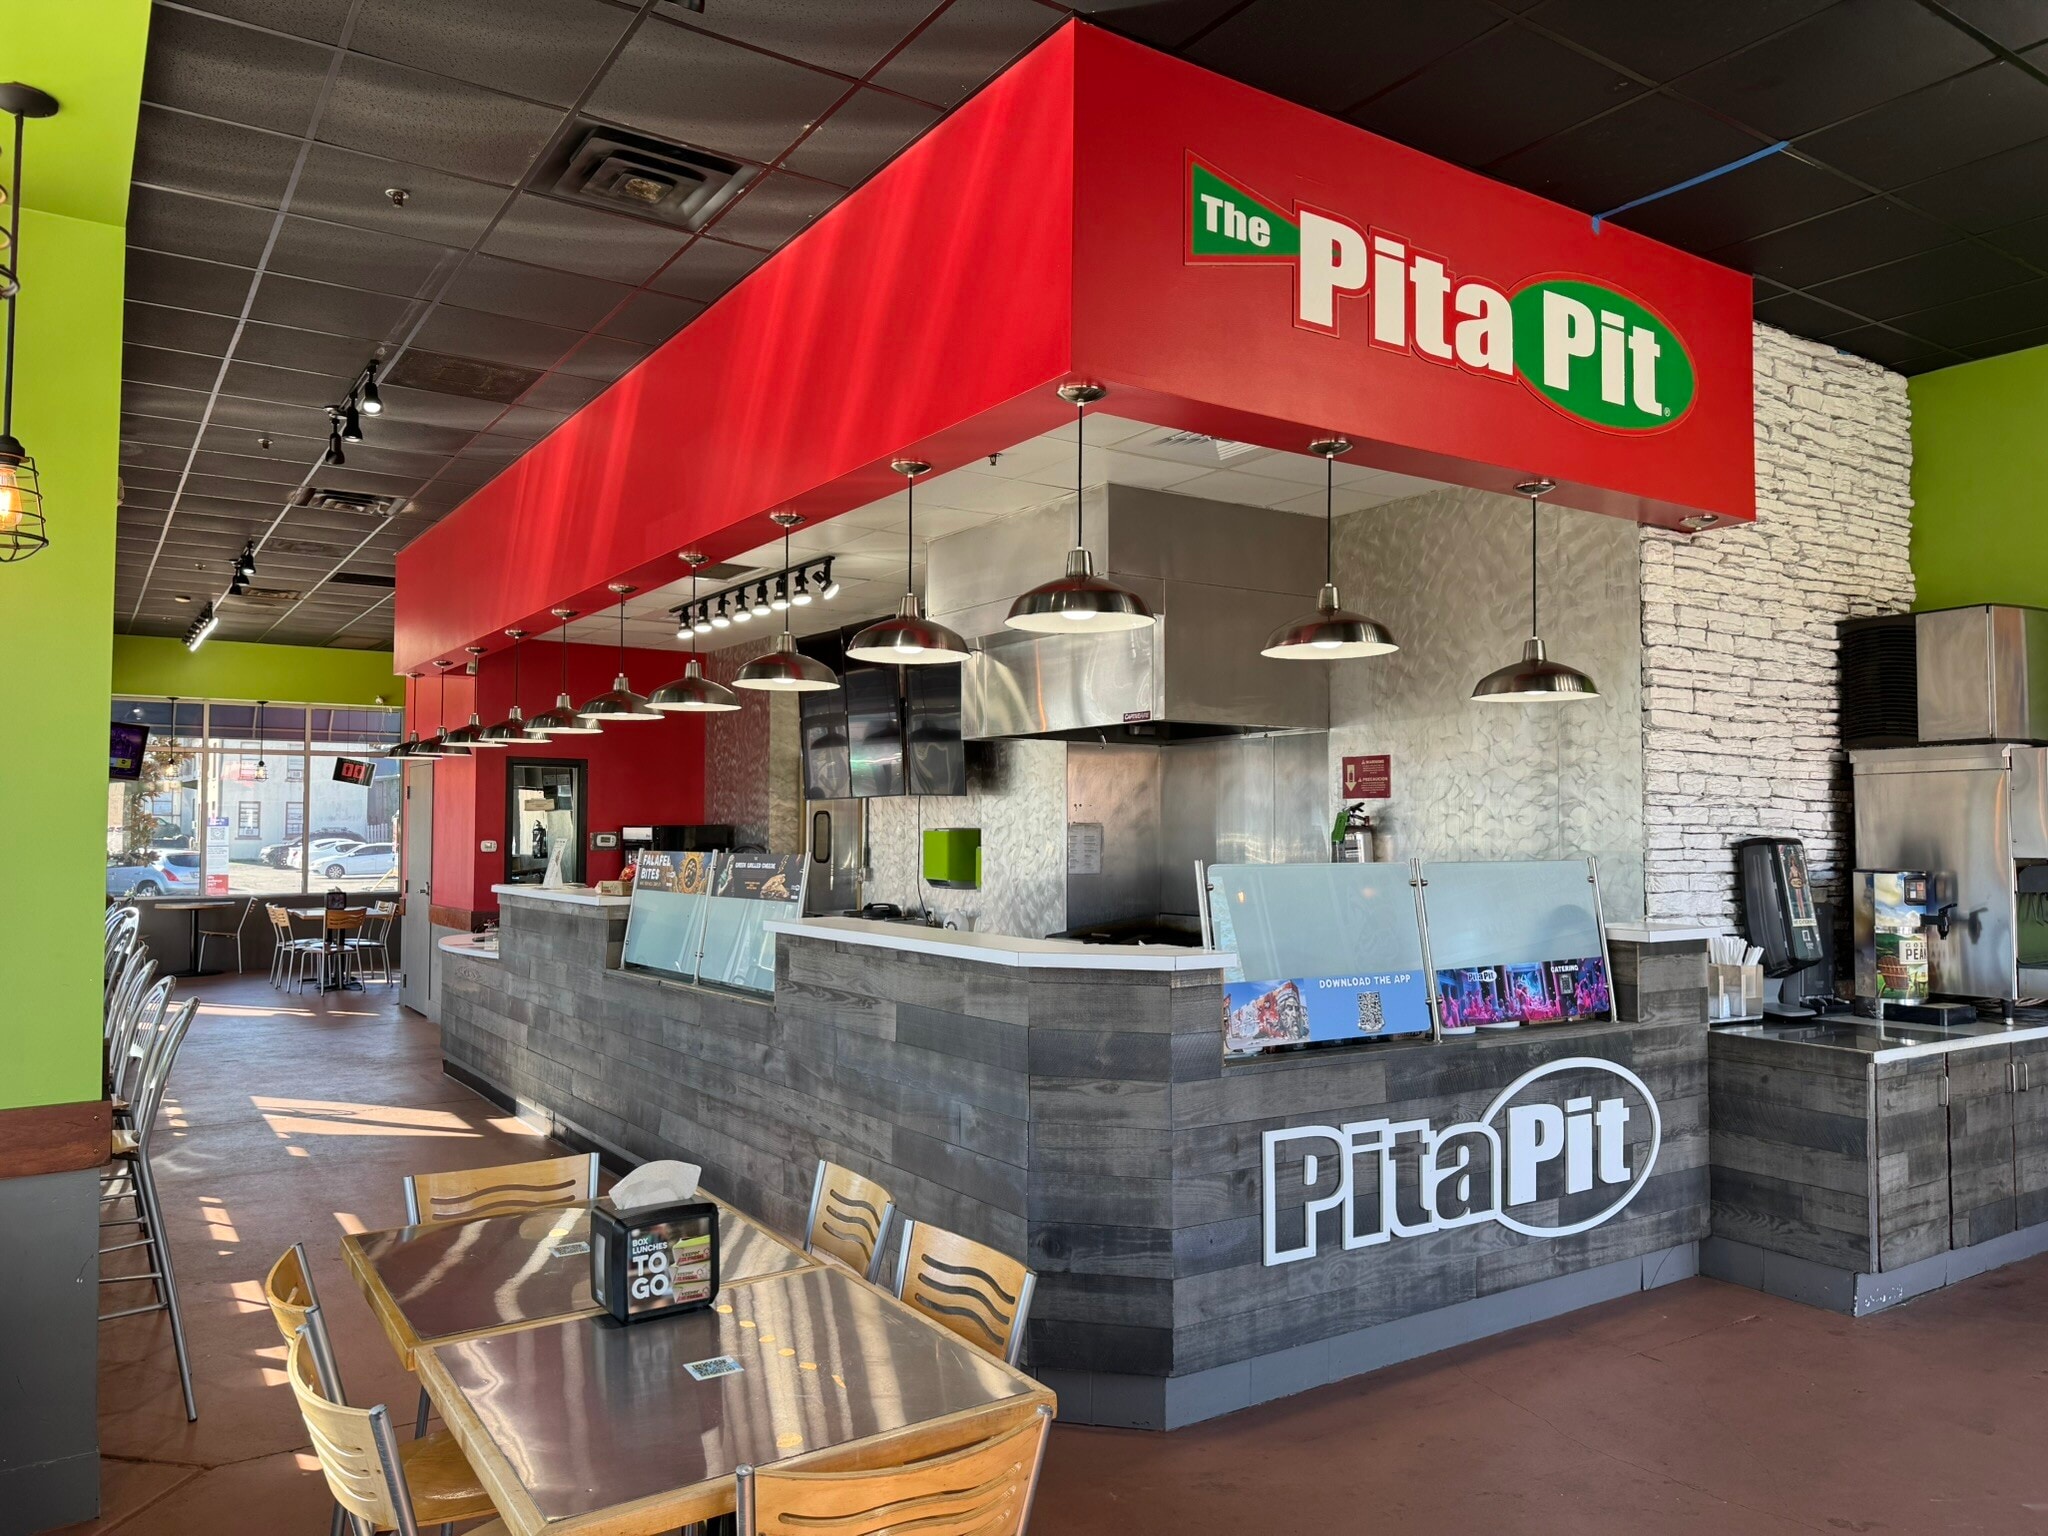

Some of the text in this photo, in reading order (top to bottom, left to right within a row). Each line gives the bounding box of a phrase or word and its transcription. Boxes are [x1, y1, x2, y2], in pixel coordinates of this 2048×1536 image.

[1201, 193, 1270, 247] The
[1299, 210, 1514, 375] Pita
[643, 854, 671, 867] FALAFEL
[641, 868, 660, 880] BITES
[1551, 965, 1579, 973] CATERING
[1319, 974, 1411, 989] DOWNLOAD THE APP
[632, 1238, 648, 1247] BOX
[632, 1241, 668, 1255] LUNCHES
[632, 1251, 668, 1277] TO
[631, 1273, 669, 1300] GO
